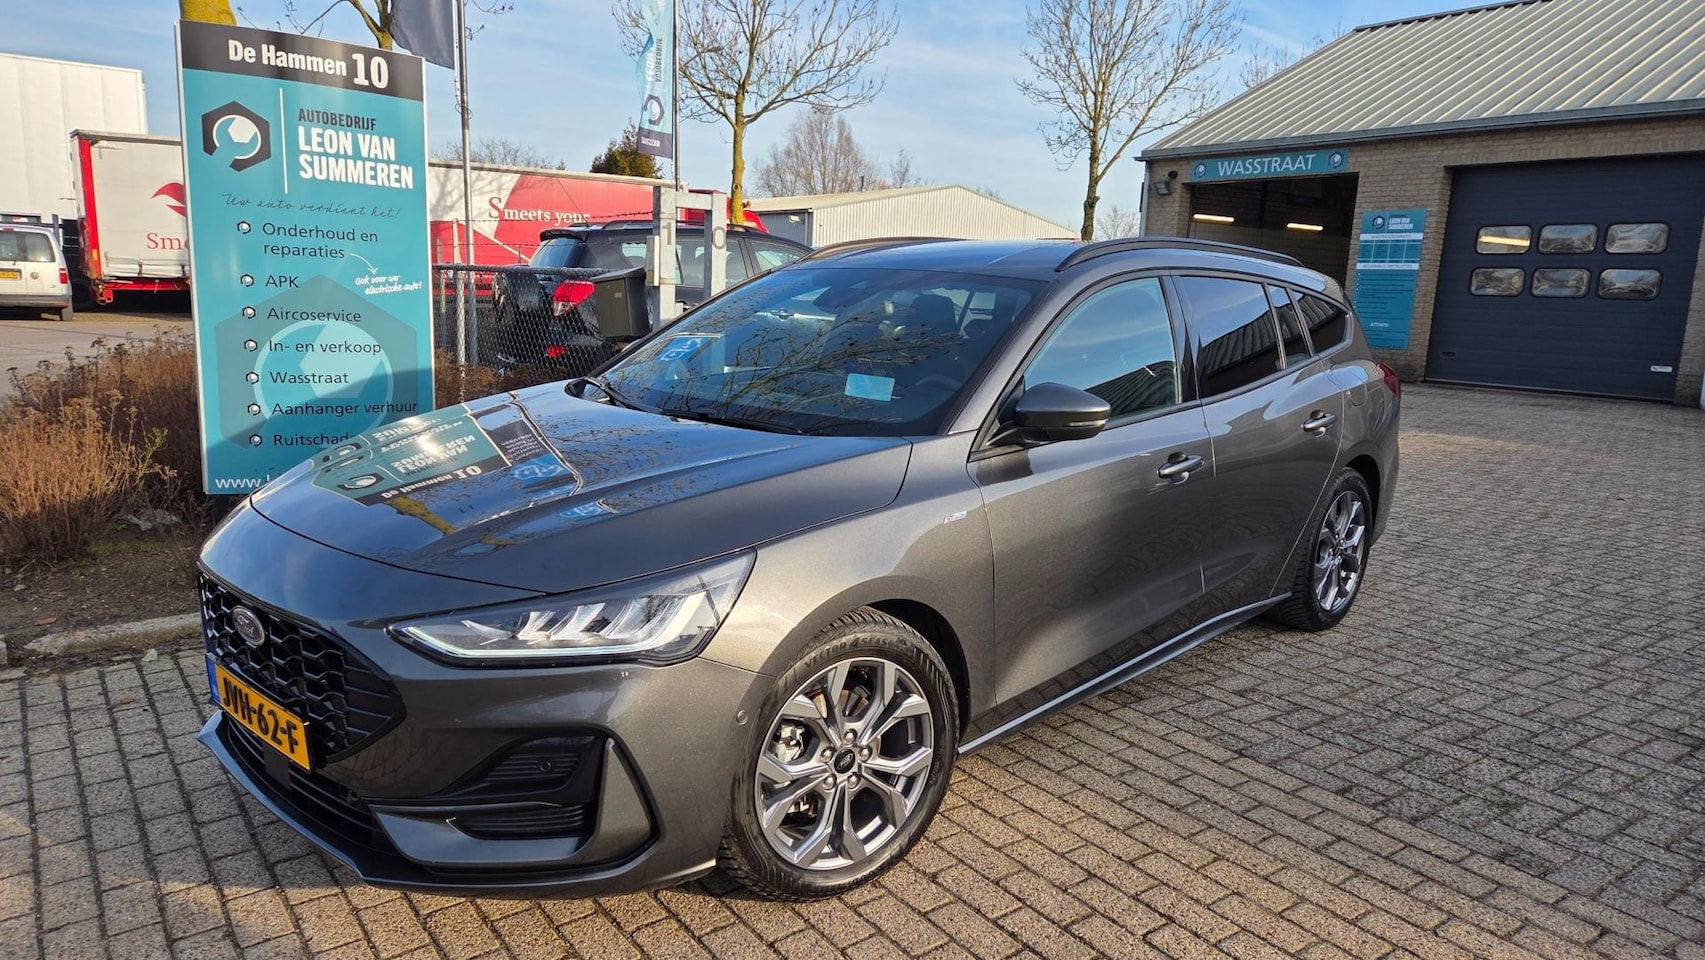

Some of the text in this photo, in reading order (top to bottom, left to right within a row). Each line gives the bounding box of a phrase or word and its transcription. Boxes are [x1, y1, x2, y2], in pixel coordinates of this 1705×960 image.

[228, 39, 389, 89] De Hammen 10
[298, 108, 377, 131] AUTOBEDRIJF
[298, 127, 396, 162] LEON VAN
[299, 156, 413, 189] SUMMEREN
[1218, 154, 1316, 176] WASSTRAAT
[257, 199, 296, 210] auto
[299, 202, 367, 216] verdient
[370, 204, 401, 219] het!
[488, 196, 591, 227] Smeets your
[262, 222, 379, 243] Onderhoud en
[263, 243, 345, 260] reparaties
[265, 275, 300, 289] APK
[267, 307, 362, 322] Aircoservice
[269, 340, 382, 356] In- en verkoop
[270, 371, 349, 385] Wasstraat
[272, 402, 418, 418] Aanhanger verhuur
[273, 431, 350, 446] Ruitschad
[804, 641, 847, 668] VECTOR
[223, 677, 299, 755] JVH-62-F
